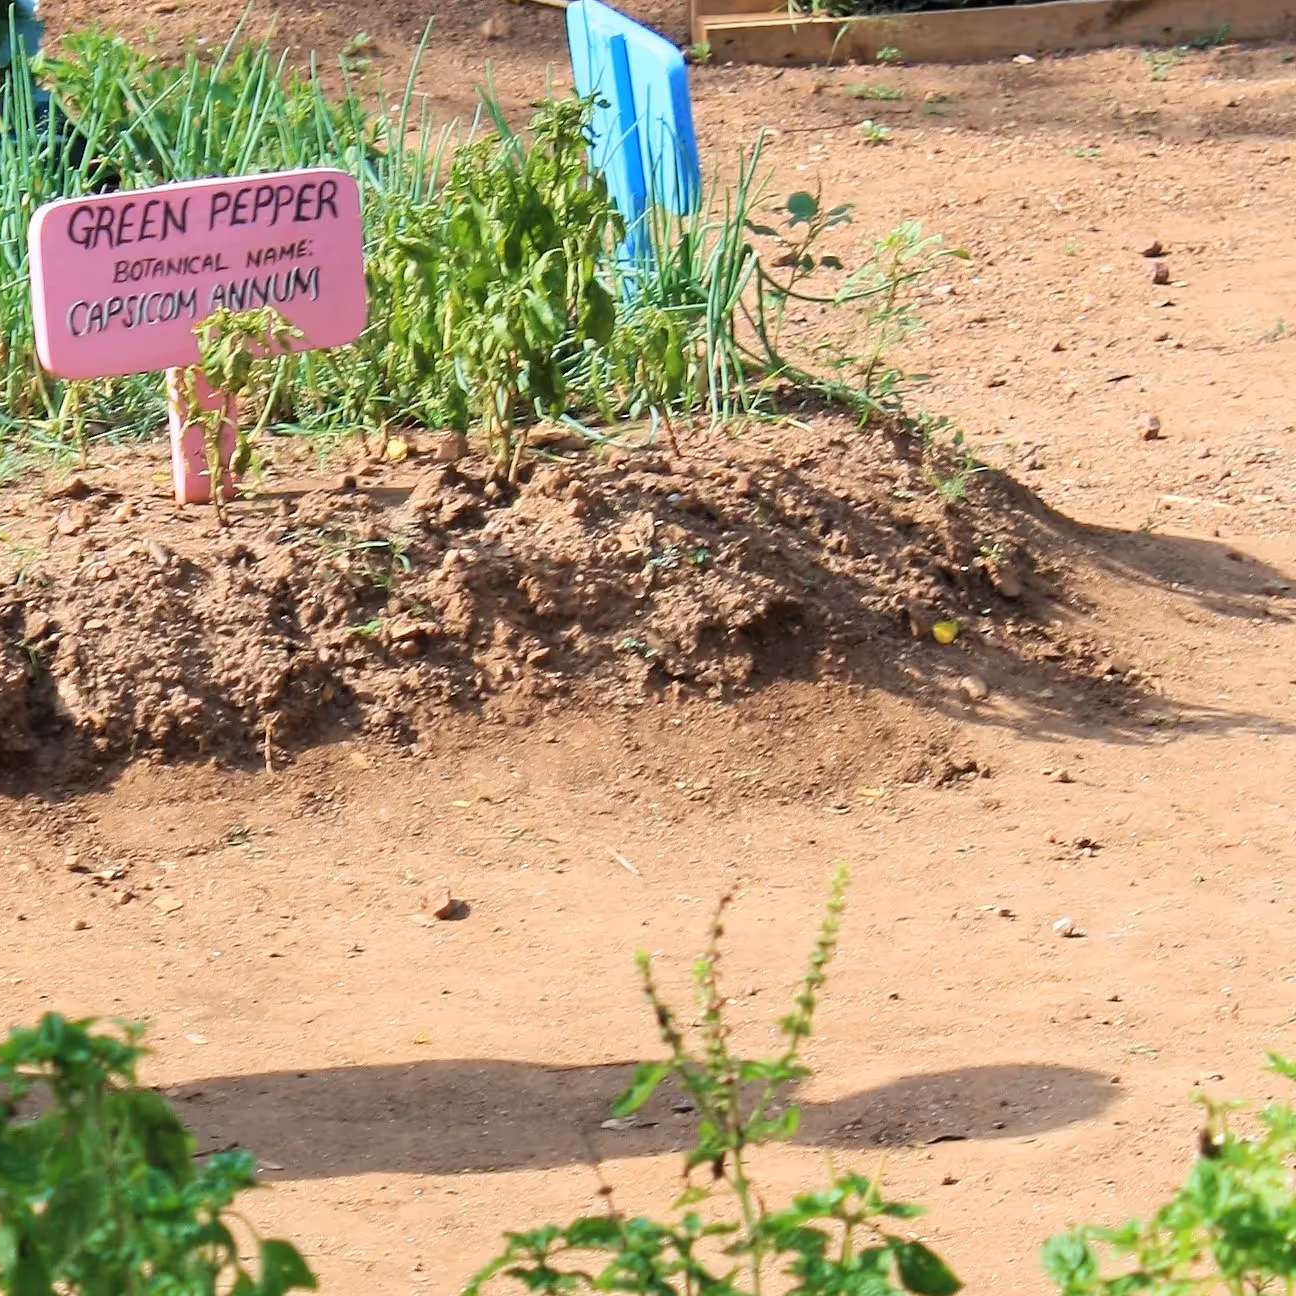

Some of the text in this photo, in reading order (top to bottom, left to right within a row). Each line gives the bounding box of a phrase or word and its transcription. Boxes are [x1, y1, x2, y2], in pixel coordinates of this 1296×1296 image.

[67, 179, 339, 250] GREEN PEPPER
[112, 239, 314, 284] BOTANICAL NAME:
[65, 265, 320, 337] CAPSICOM ANNUM
